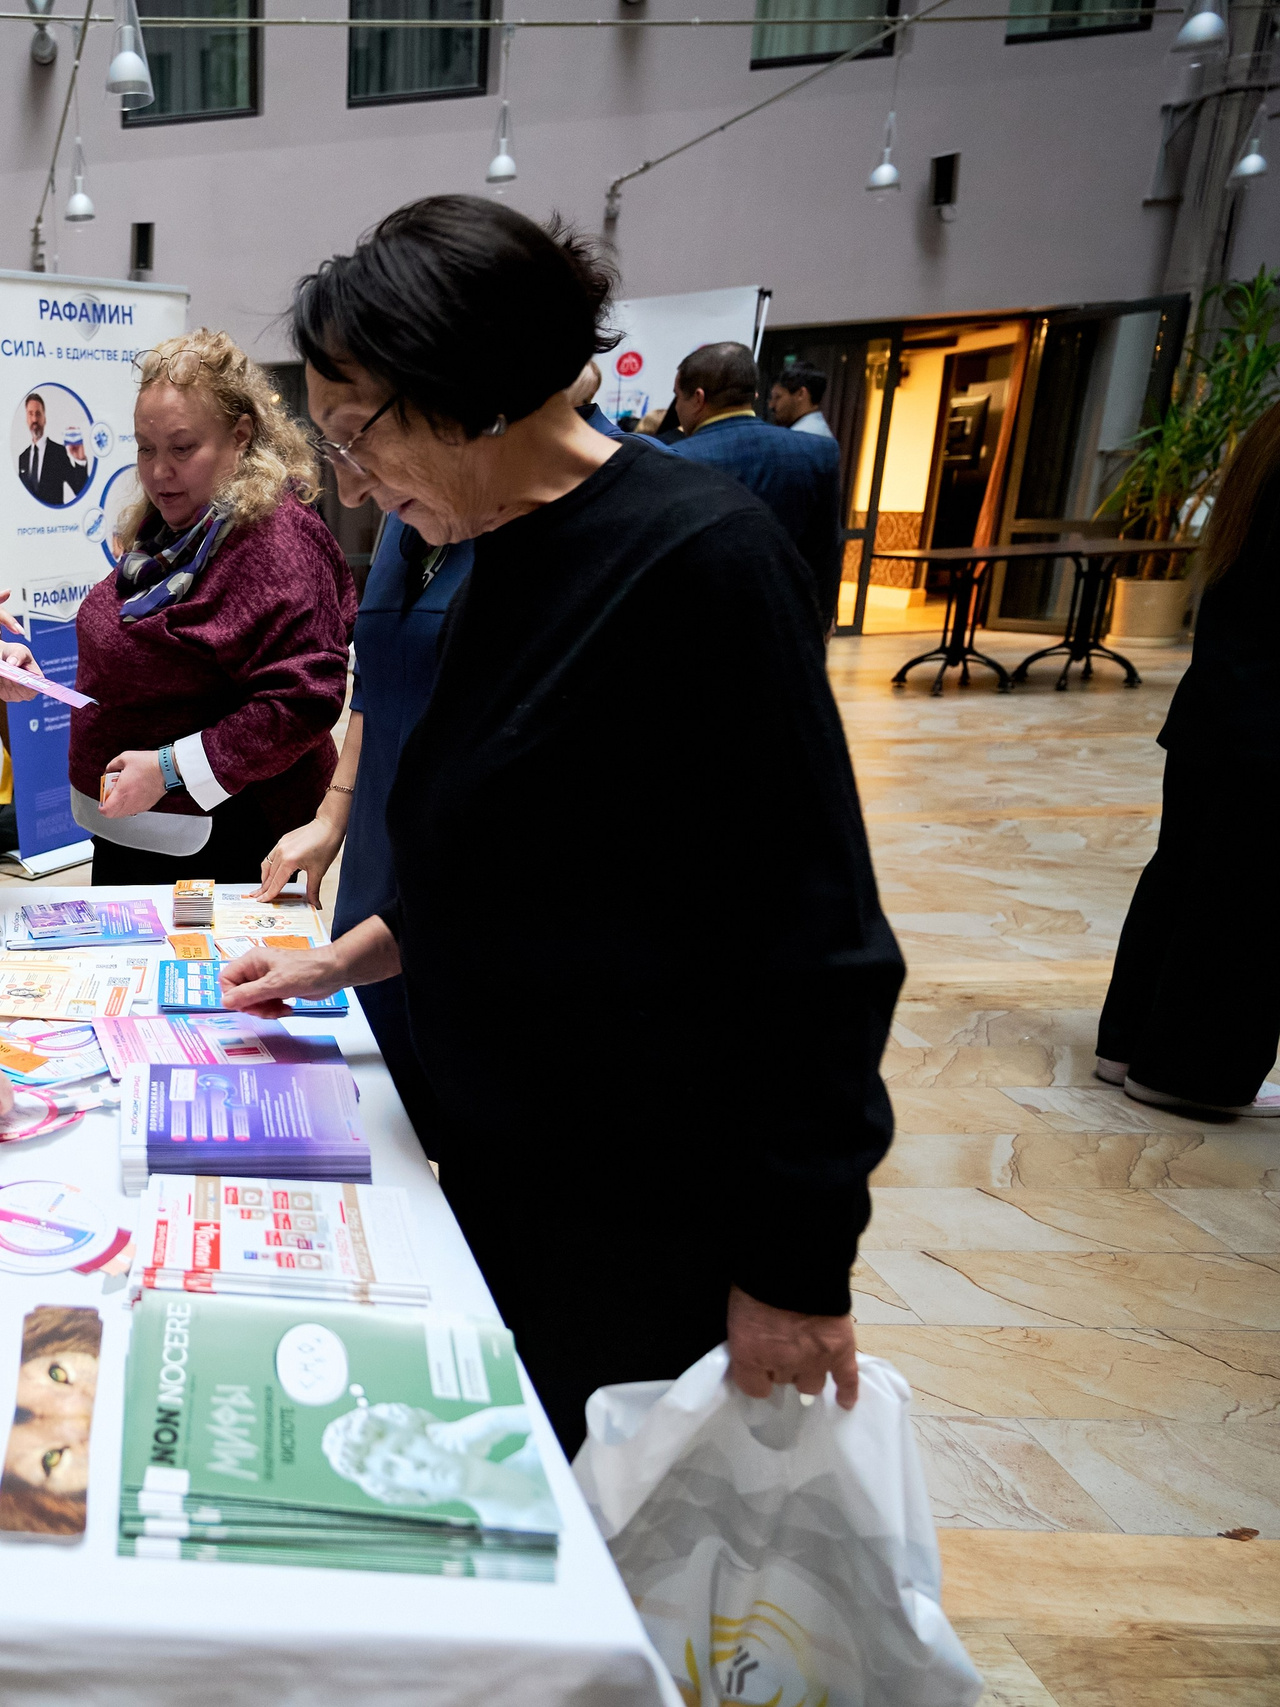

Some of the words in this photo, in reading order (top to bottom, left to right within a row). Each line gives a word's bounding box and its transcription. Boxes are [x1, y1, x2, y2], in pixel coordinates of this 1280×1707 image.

[39, 299, 133, 325] РАФАМИН
[1, 339, 46, 358] СИЛА
[56, 347, 63, 359] В
[66, 347, 119, 361] ЕДИНСТВЕ
[17, 526, 45, 536] ПРОТИВ
[46, 523, 79, 534] БАКТЕРИЙ
[149, 1081, 158, 1131] ЛОРНОКСИКАМ
[157, 1303, 191, 1406] NOCERE
[150, 1406, 181, 1466] NON
